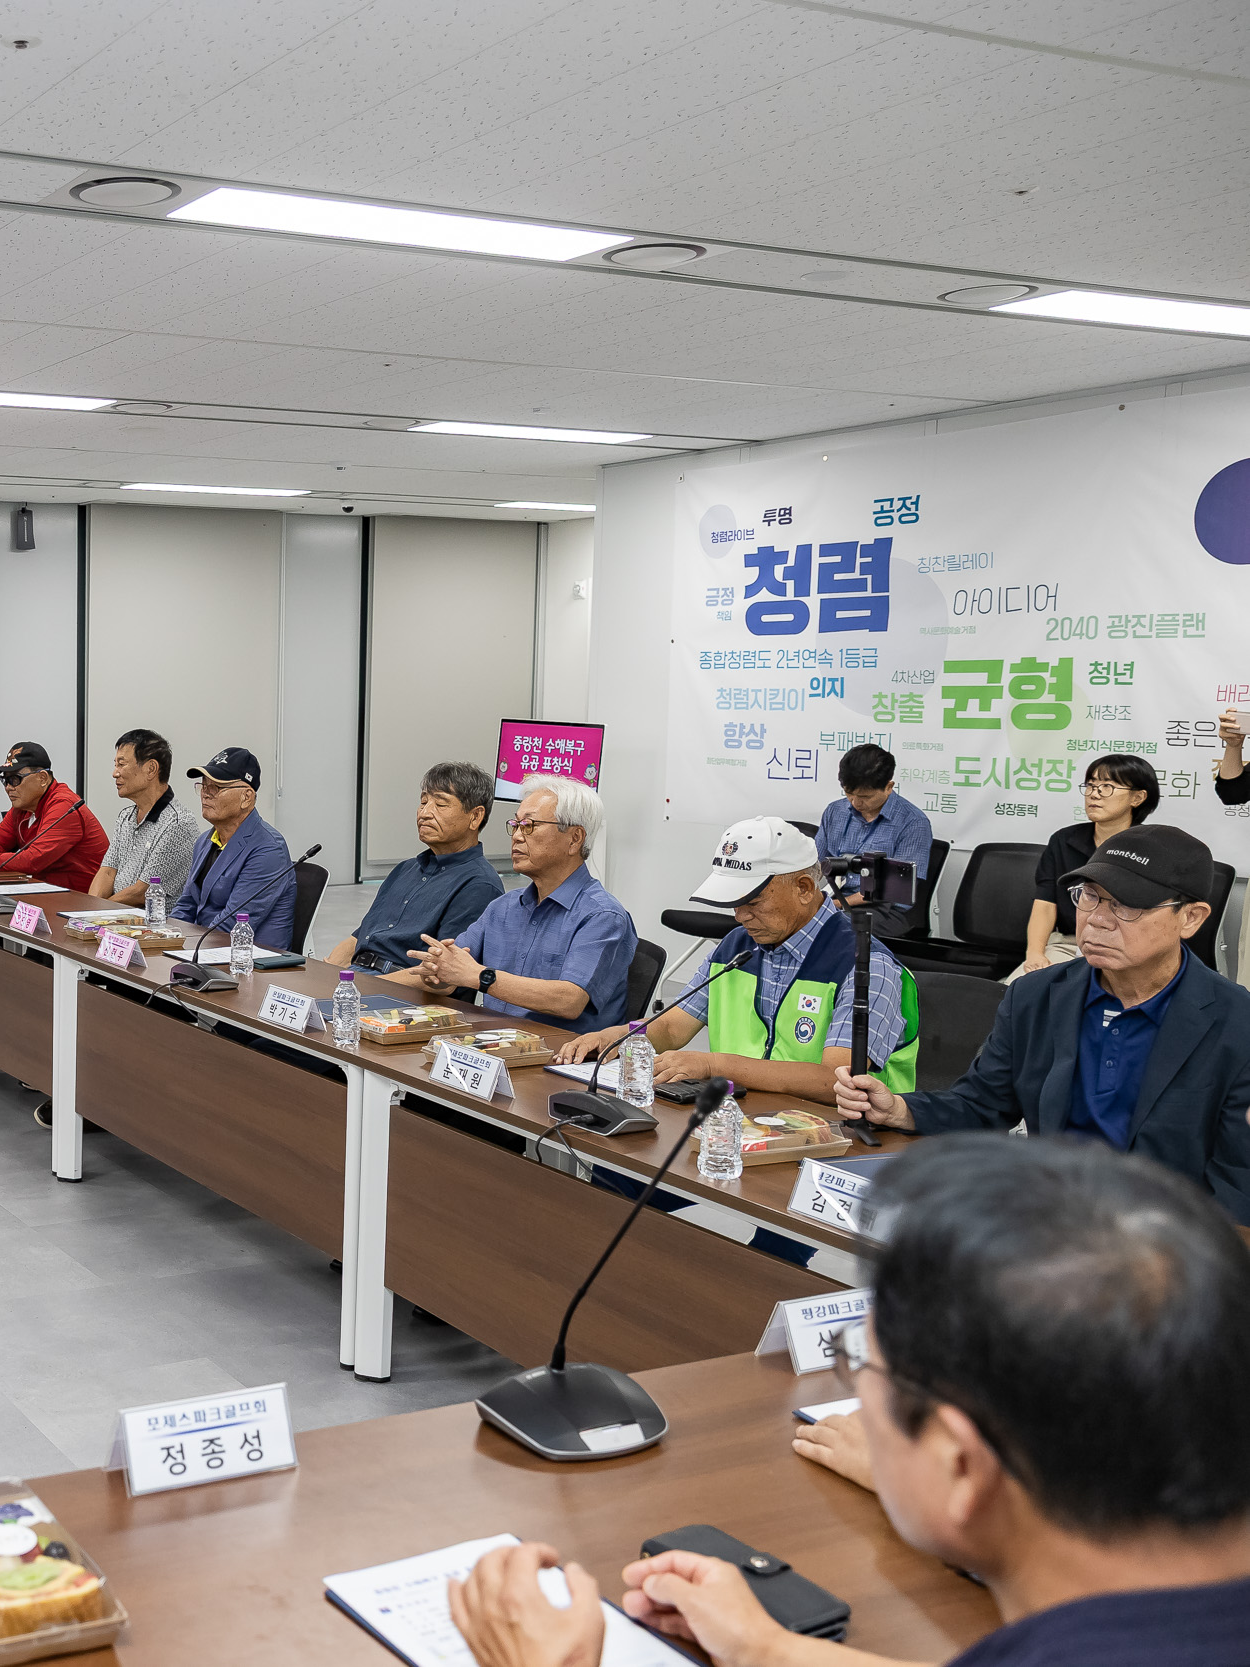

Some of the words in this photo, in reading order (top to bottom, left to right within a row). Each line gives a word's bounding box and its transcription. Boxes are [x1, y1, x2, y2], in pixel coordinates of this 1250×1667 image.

[762, 506, 793, 526] 투명
[872, 495, 921, 527] 공정
[711, 528, 755, 543] 청렴라이브
[918, 552, 994, 574] 칭찬릴레이
[705, 587, 735, 607] 긍정
[744, 537, 893, 636] 청렴
[953, 583, 1059, 616] 아이디어
[1046, 615, 1099, 641] 2040
[1107, 612, 1206, 639] 광진플랜
[699, 650, 772, 670] 종합청렴도
[776, 649, 834, 669] 2년연속
[839, 647, 878, 669] 1등급
[891, 669, 935, 684] 4차산업
[1089, 661, 1135, 685] 청년
[809, 677, 845, 698] 의지
[941, 657, 1074, 731] 균형
[716, 687, 805, 711] 청렴지킴이
[872, 692, 925, 724] 창출
[1086, 705, 1132, 721] 재창조
[513, 735, 543, 753] 중랑천
[545, 738, 585, 756] 수해복구
[723, 722, 767, 750] 향상
[1066, 739, 1158, 754] 청년지식문화거점
[520, 754, 540, 771] 유공
[542, 756, 573, 774] 표창식
[766, 748, 819, 782] 신뢰
[953, 756, 1076, 793] 도시성장
[900, 768, 950, 784] 취약계층
[922, 792, 958, 814] 교통
[994, 802, 1038, 818] 성장동력
[724, 859, 752, 871] MIDAS
[270, 1003, 297, 1024] 박기수
[161, 1429, 264, 1476] 정종성
